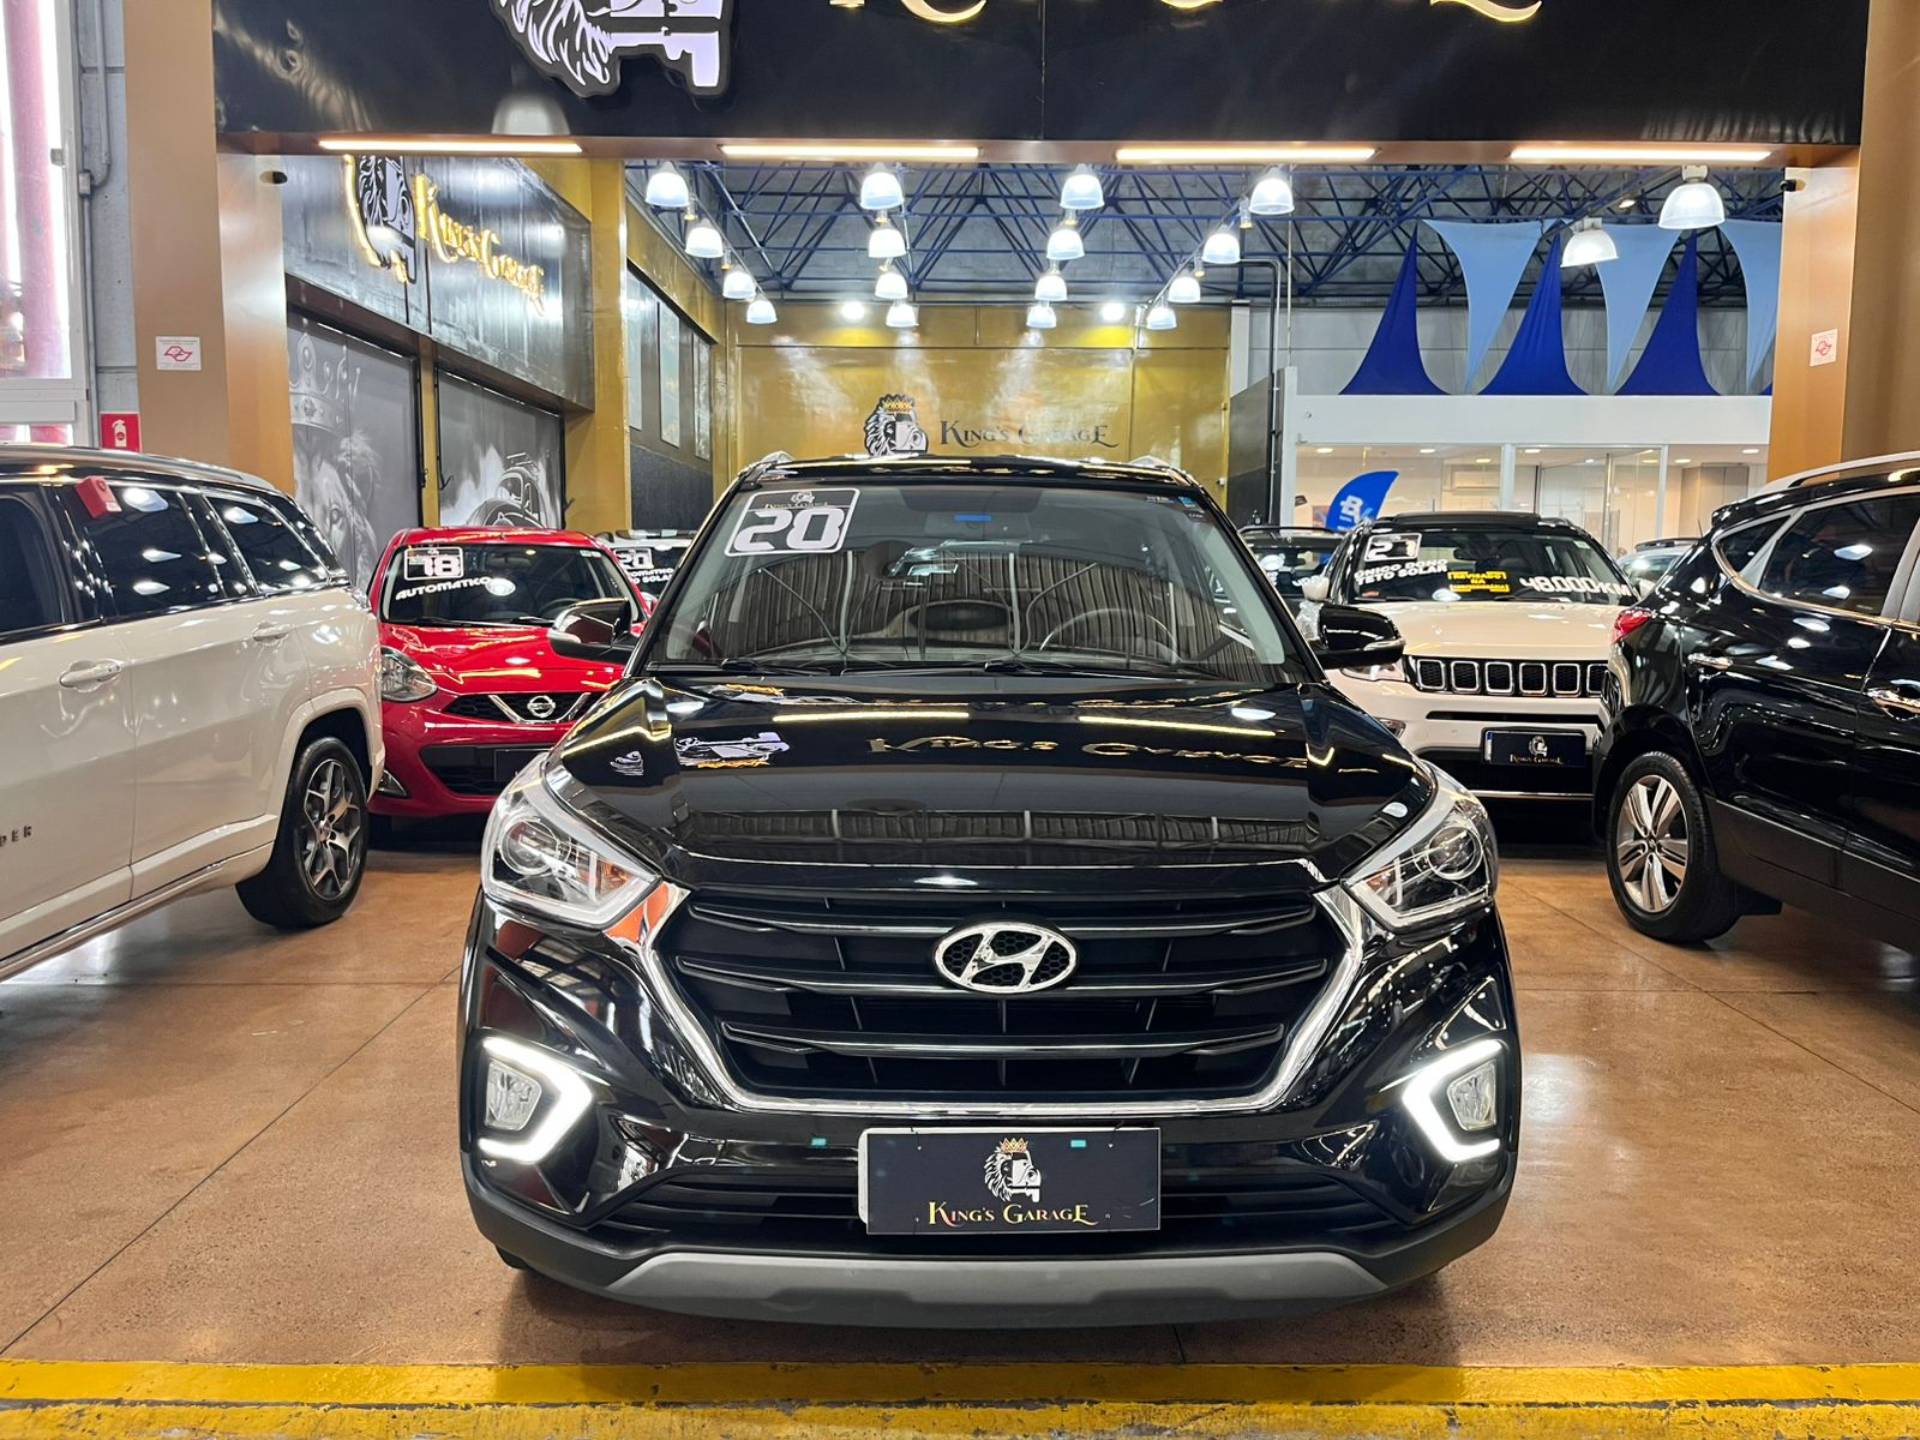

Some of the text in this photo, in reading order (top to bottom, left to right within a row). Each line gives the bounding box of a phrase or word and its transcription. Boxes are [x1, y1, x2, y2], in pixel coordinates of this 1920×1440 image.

[733, 508, 845, 551] 20
[1367, 541, 1418, 559] 21
[928, 1201, 1100, 1227] KING'S GARAGE
